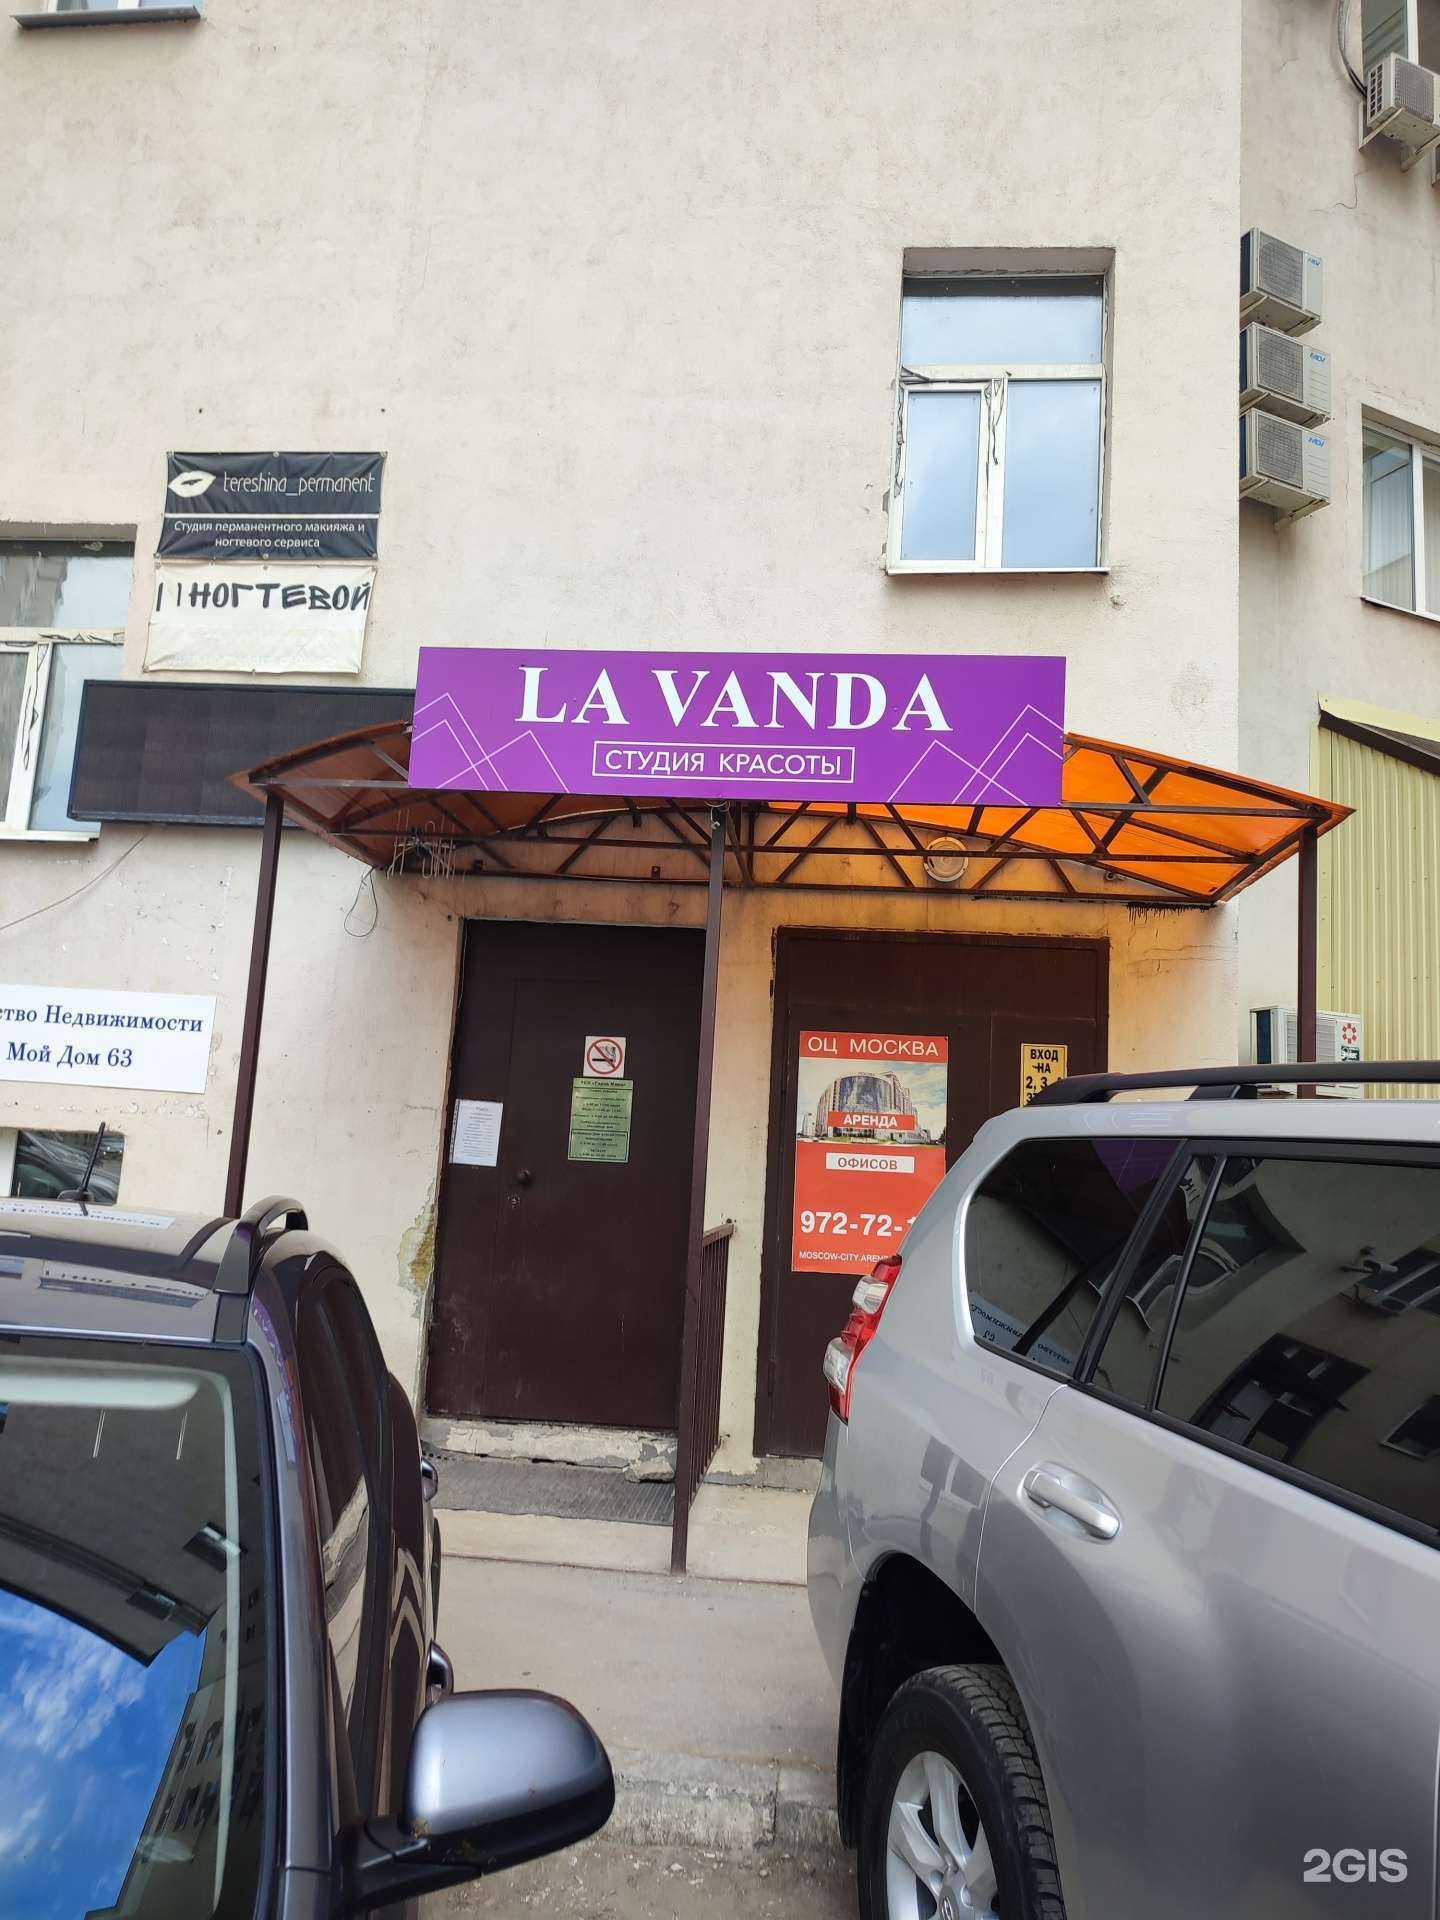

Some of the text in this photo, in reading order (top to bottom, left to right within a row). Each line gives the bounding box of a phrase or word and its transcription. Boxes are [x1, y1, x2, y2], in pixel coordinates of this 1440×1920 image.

[223, 471, 376, 496] tereshina_permanent
[174, 520, 365, 534] Студия перманентного макияжа и
[215, 538, 320, 549] ногтевого сервиса
[188, 581, 371, 612] НОГТЕВОЙ
[514, 666, 954, 732] LA VANDA
[604, 749, 841, 776] СТУДИЯ КРАСОТЫ
[0, 1004, 204, 1032] тво Недвижимости
[6, 1041, 133, 1069] Мой Дом 63
[807, 1036, 939, 1057] ОЦ МОСКВА
[1030, 1048, 1059, 1062] ВХОД
[1037, 1062, 1051, 1074] НА
[843, 1114, 898, 1128] АРЕНДА
[837, 1157, 898, 1170] ОФИСОВ
